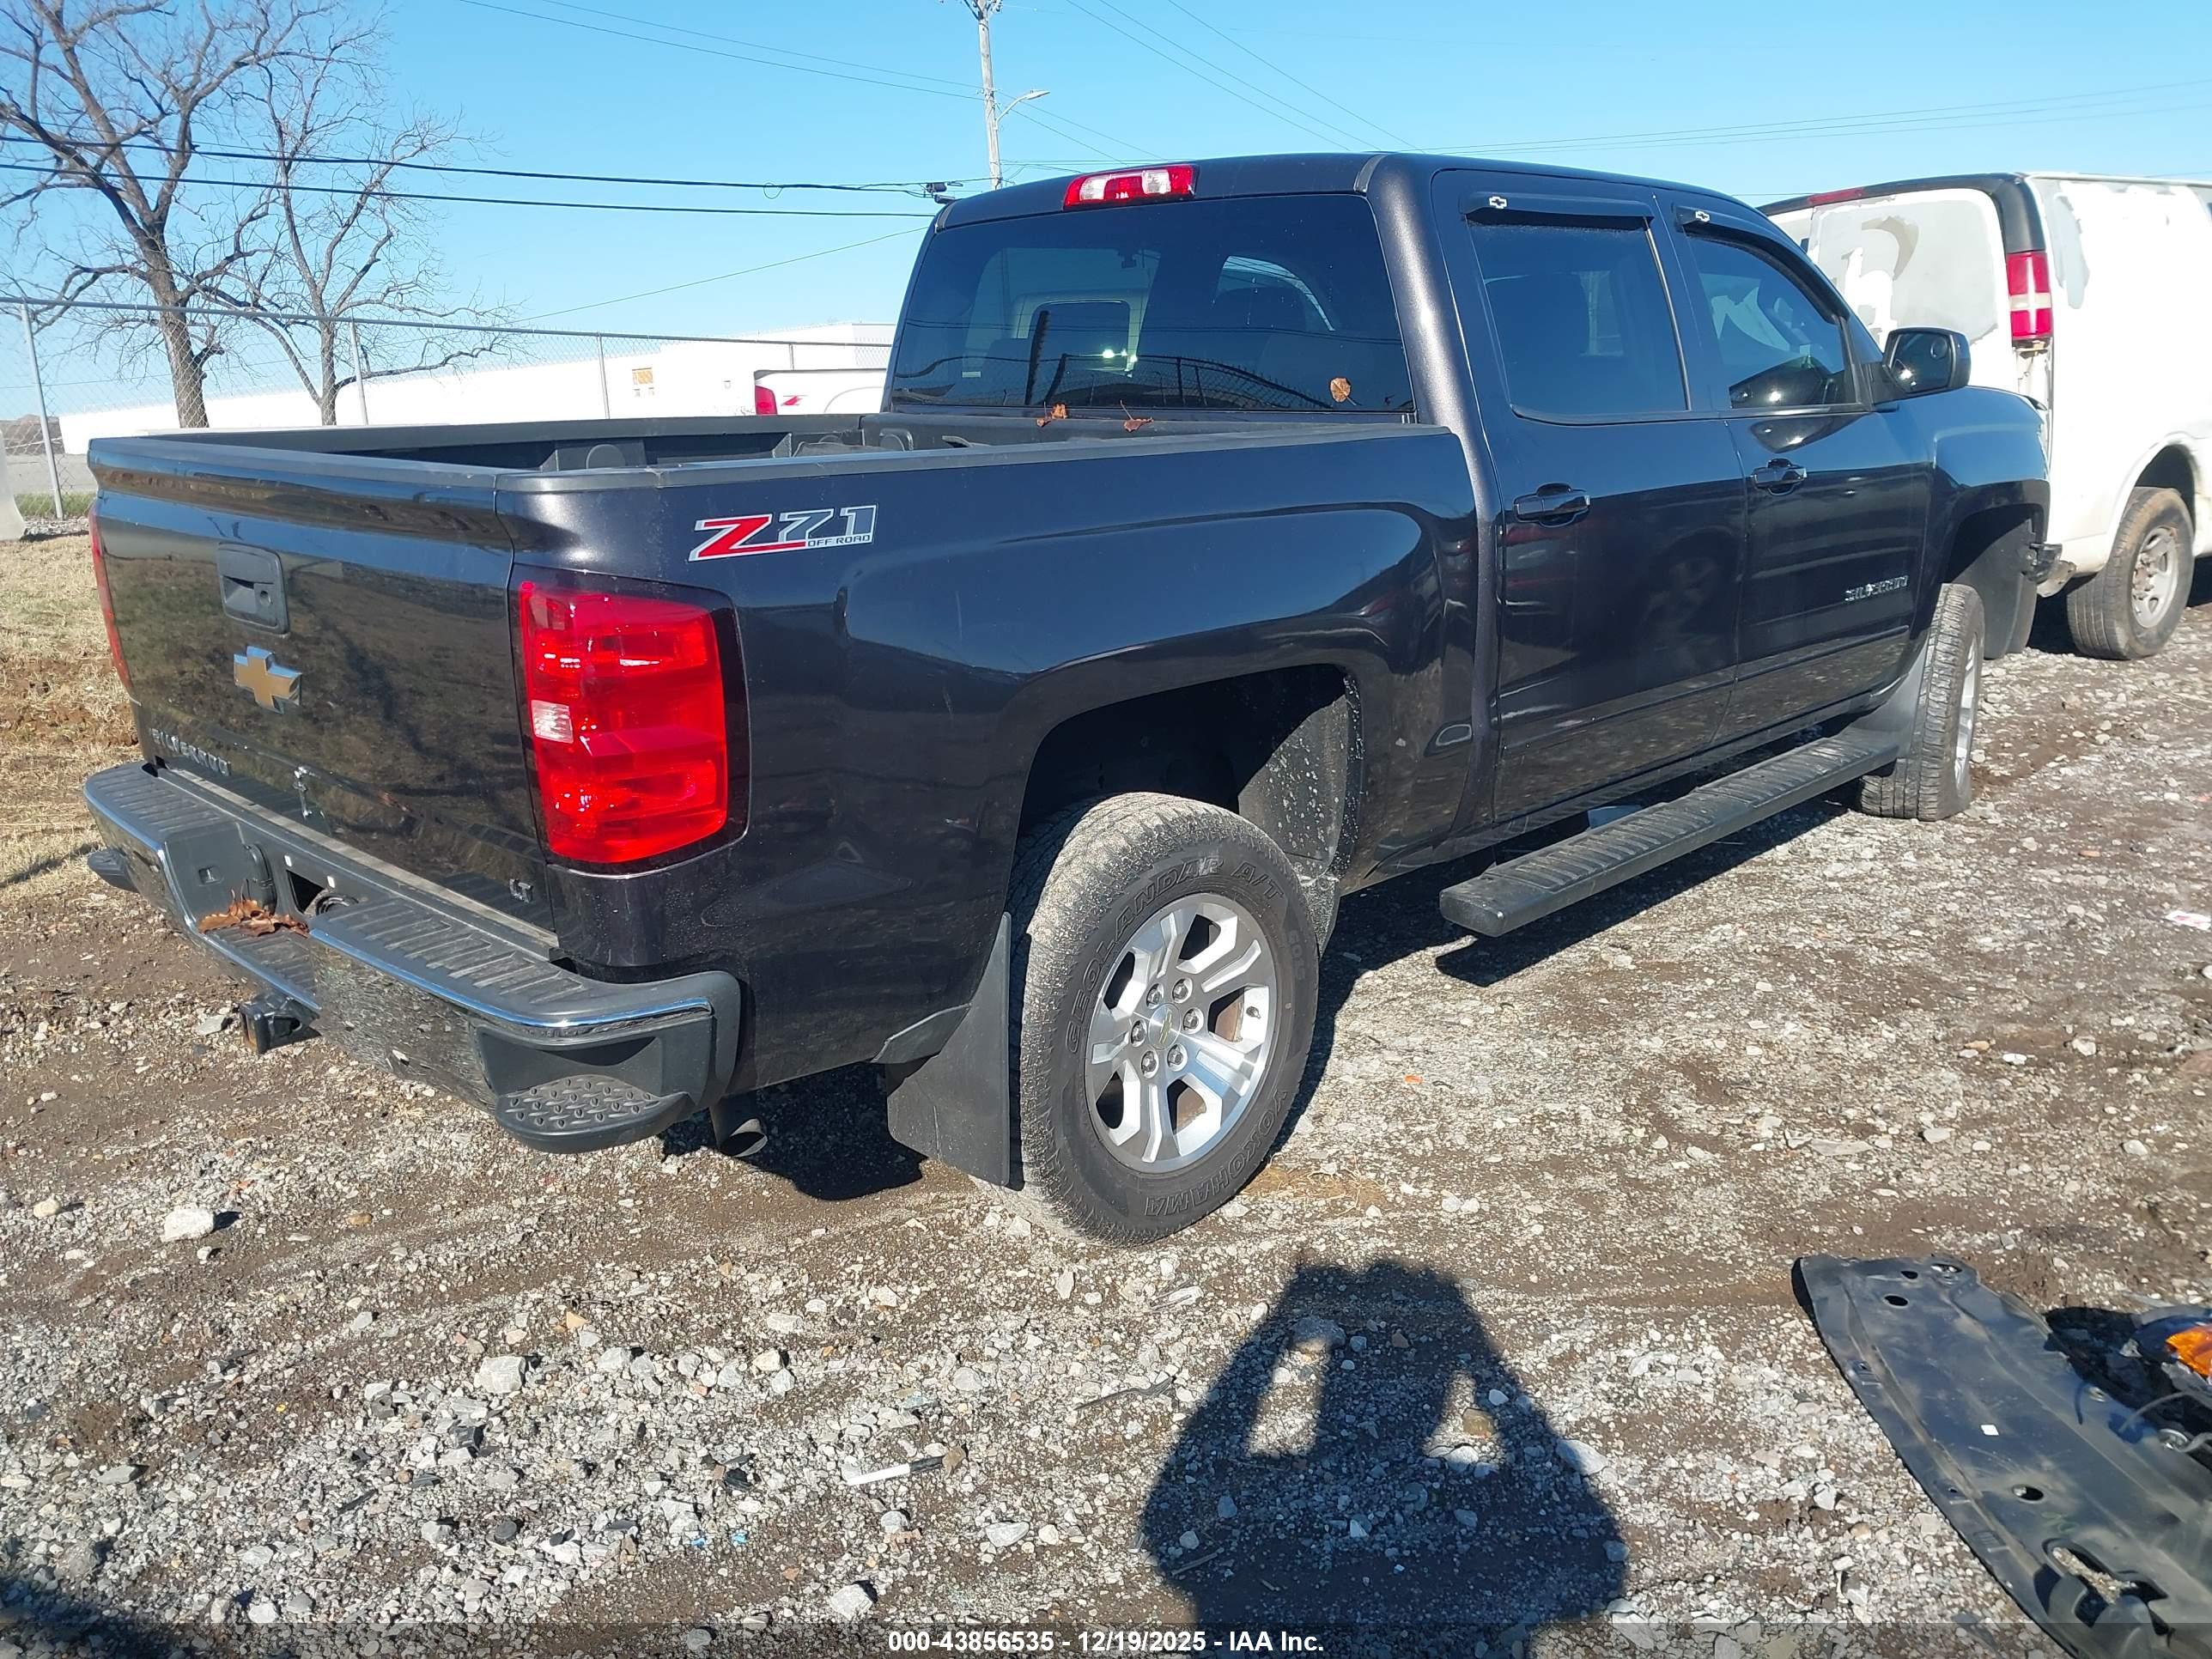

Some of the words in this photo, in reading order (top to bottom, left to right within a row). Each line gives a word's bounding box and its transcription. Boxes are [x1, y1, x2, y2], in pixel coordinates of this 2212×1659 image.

[688, 503, 878, 562] Z71
[807, 538, 833, 547] OFF
[836, 534, 871, 544] ROAD
[509, 878, 531, 903] LT
[1066, 858, 1224, 1054] GEOLANDAR
[1231, 862, 1285, 900] A/T
[1145, 1088, 1286, 1216] YOKOHAMA
